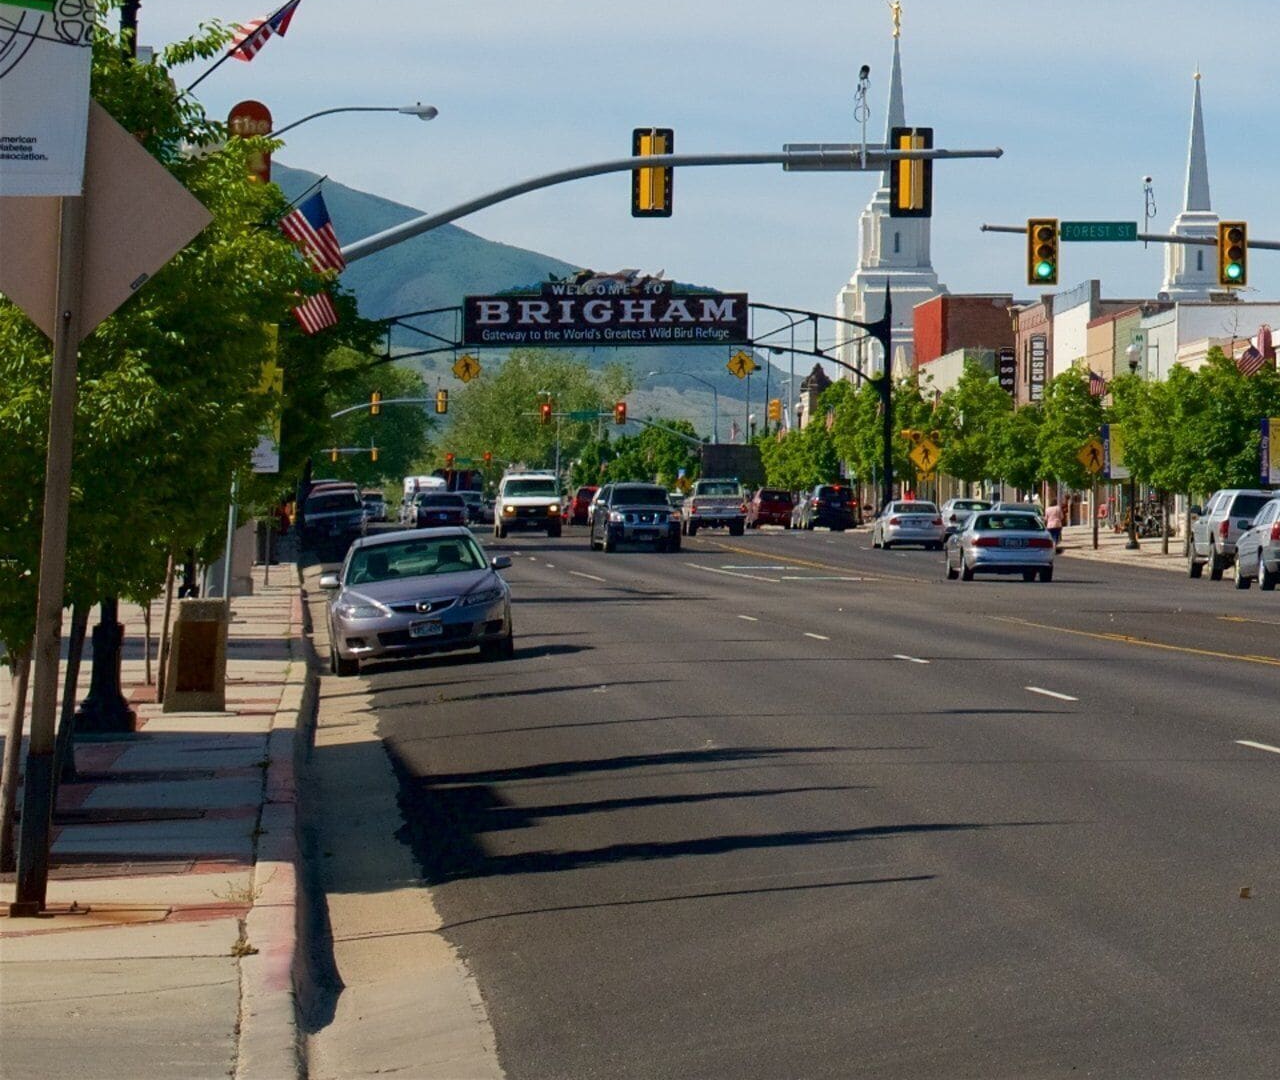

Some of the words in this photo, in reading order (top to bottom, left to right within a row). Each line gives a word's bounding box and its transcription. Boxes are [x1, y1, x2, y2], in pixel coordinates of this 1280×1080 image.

[0, 136, 37, 144] merican
[1065, 225, 1111, 237] FOREST
[1118, 225, 1131, 237] ST
[552, 283, 631, 295] WELCOME
[476, 299, 737, 325] BRIGHAM
[482, 329, 526, 341] Gateway
[530, 330, 541, 340] to
[544, 329, 560, 340] the
[563, 328, 601, 340] World's
[604, 328, 646, 340] Greatest
[649, 327, 672, 338] Wild
[674, 327, 694, 338] Bird
[696, 327, 730, 341] Refuge
